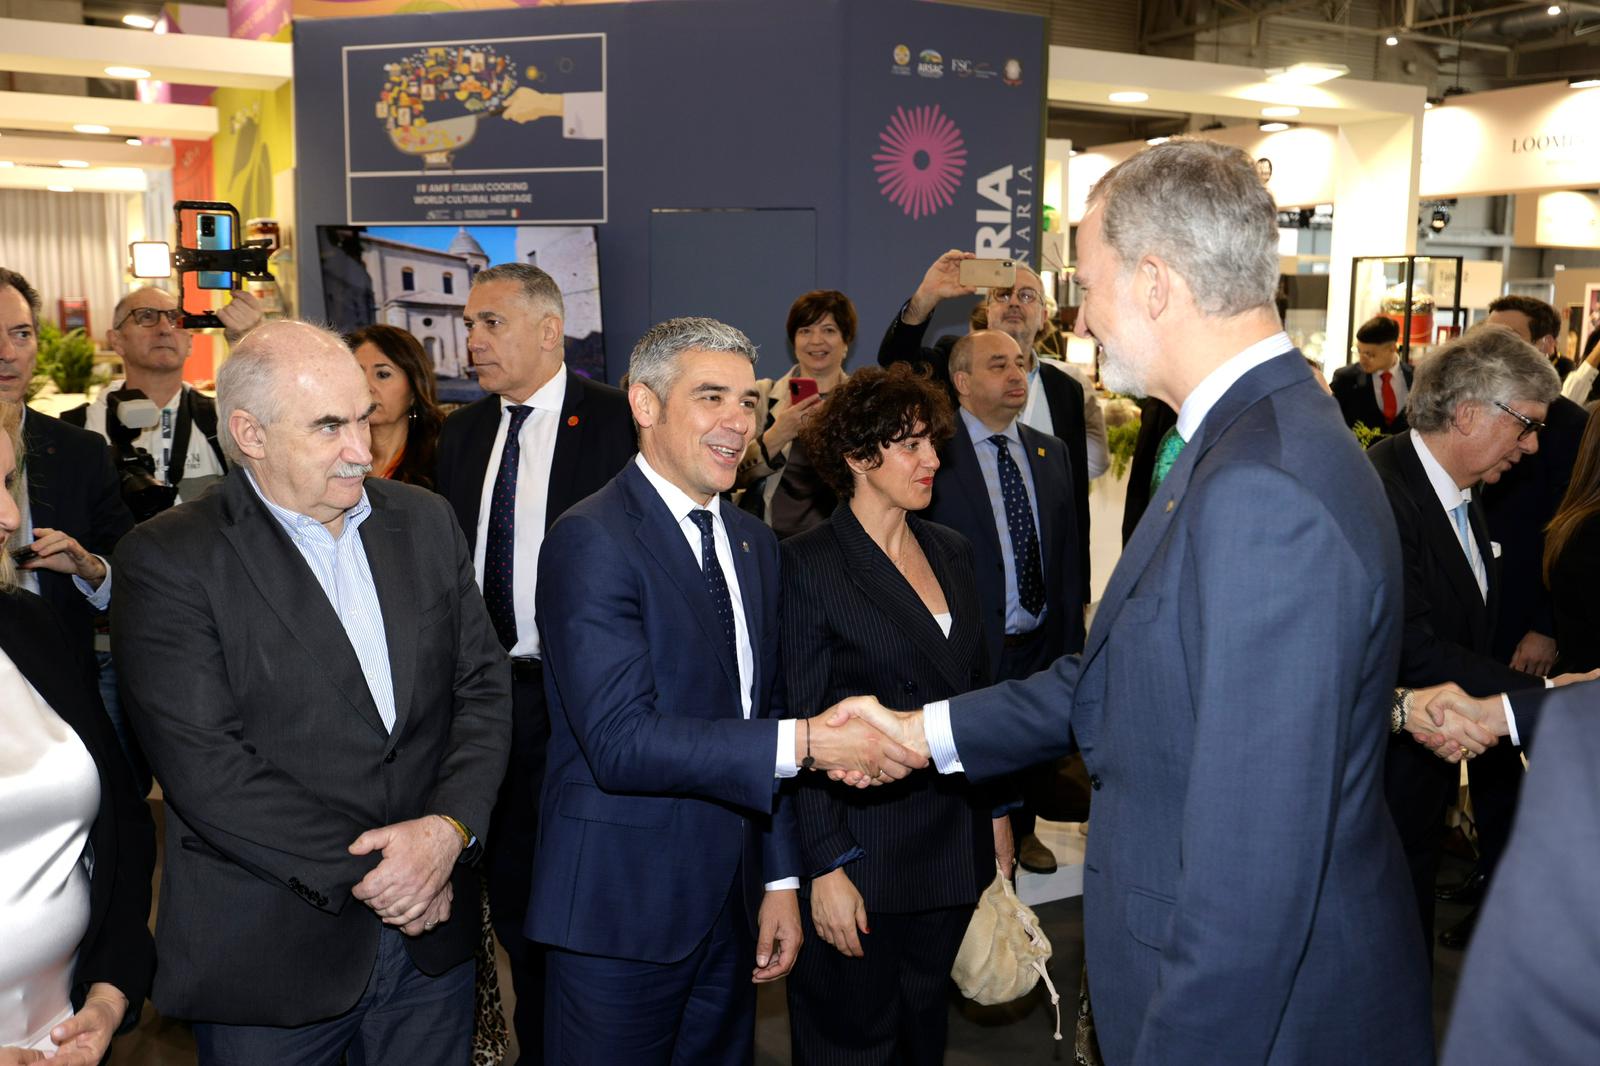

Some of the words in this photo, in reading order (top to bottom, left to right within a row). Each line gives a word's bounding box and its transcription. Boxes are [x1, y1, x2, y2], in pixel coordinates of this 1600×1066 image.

[413, 195, 445, 205] WORLD
[445, 194, 489, 204] CULTURAL
[489, 193, 533, 203] HERITAGE
[451, 182, 485, 192] ITALIAN
[485, 181, 528, 192] COOKING
[975, 164, 1014, 260] RIA
[1015, 166, 1033, 263] NARIA
